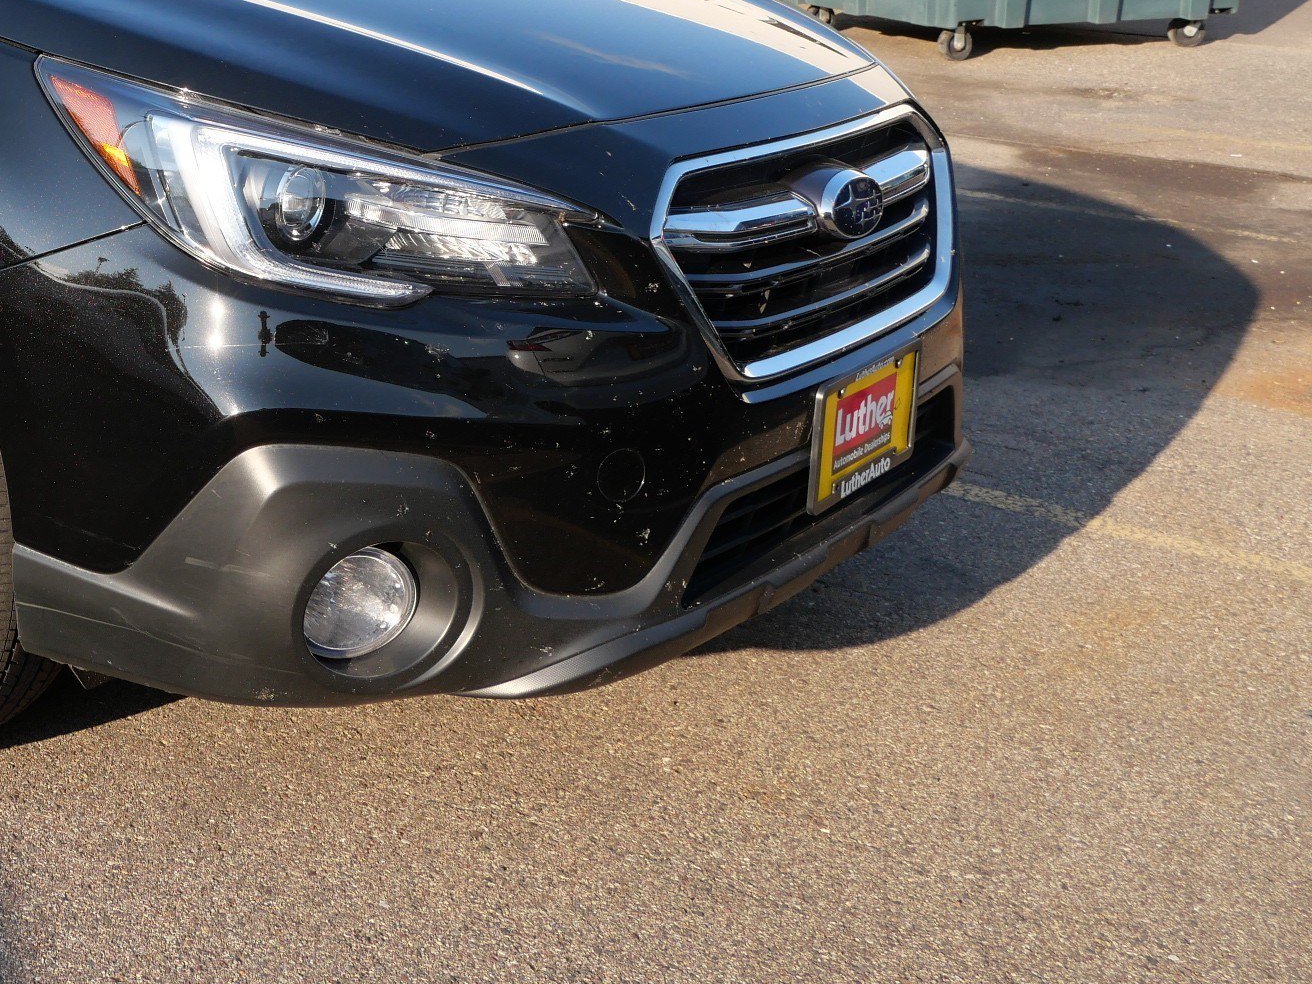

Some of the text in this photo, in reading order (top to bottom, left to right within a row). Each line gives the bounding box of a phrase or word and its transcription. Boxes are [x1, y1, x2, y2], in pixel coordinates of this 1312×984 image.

[835, 390, 894, 447] Luther
[833, 432, 891, 470] Automobile Dealerships
[840, 457, 891, 499] LutherAuto
